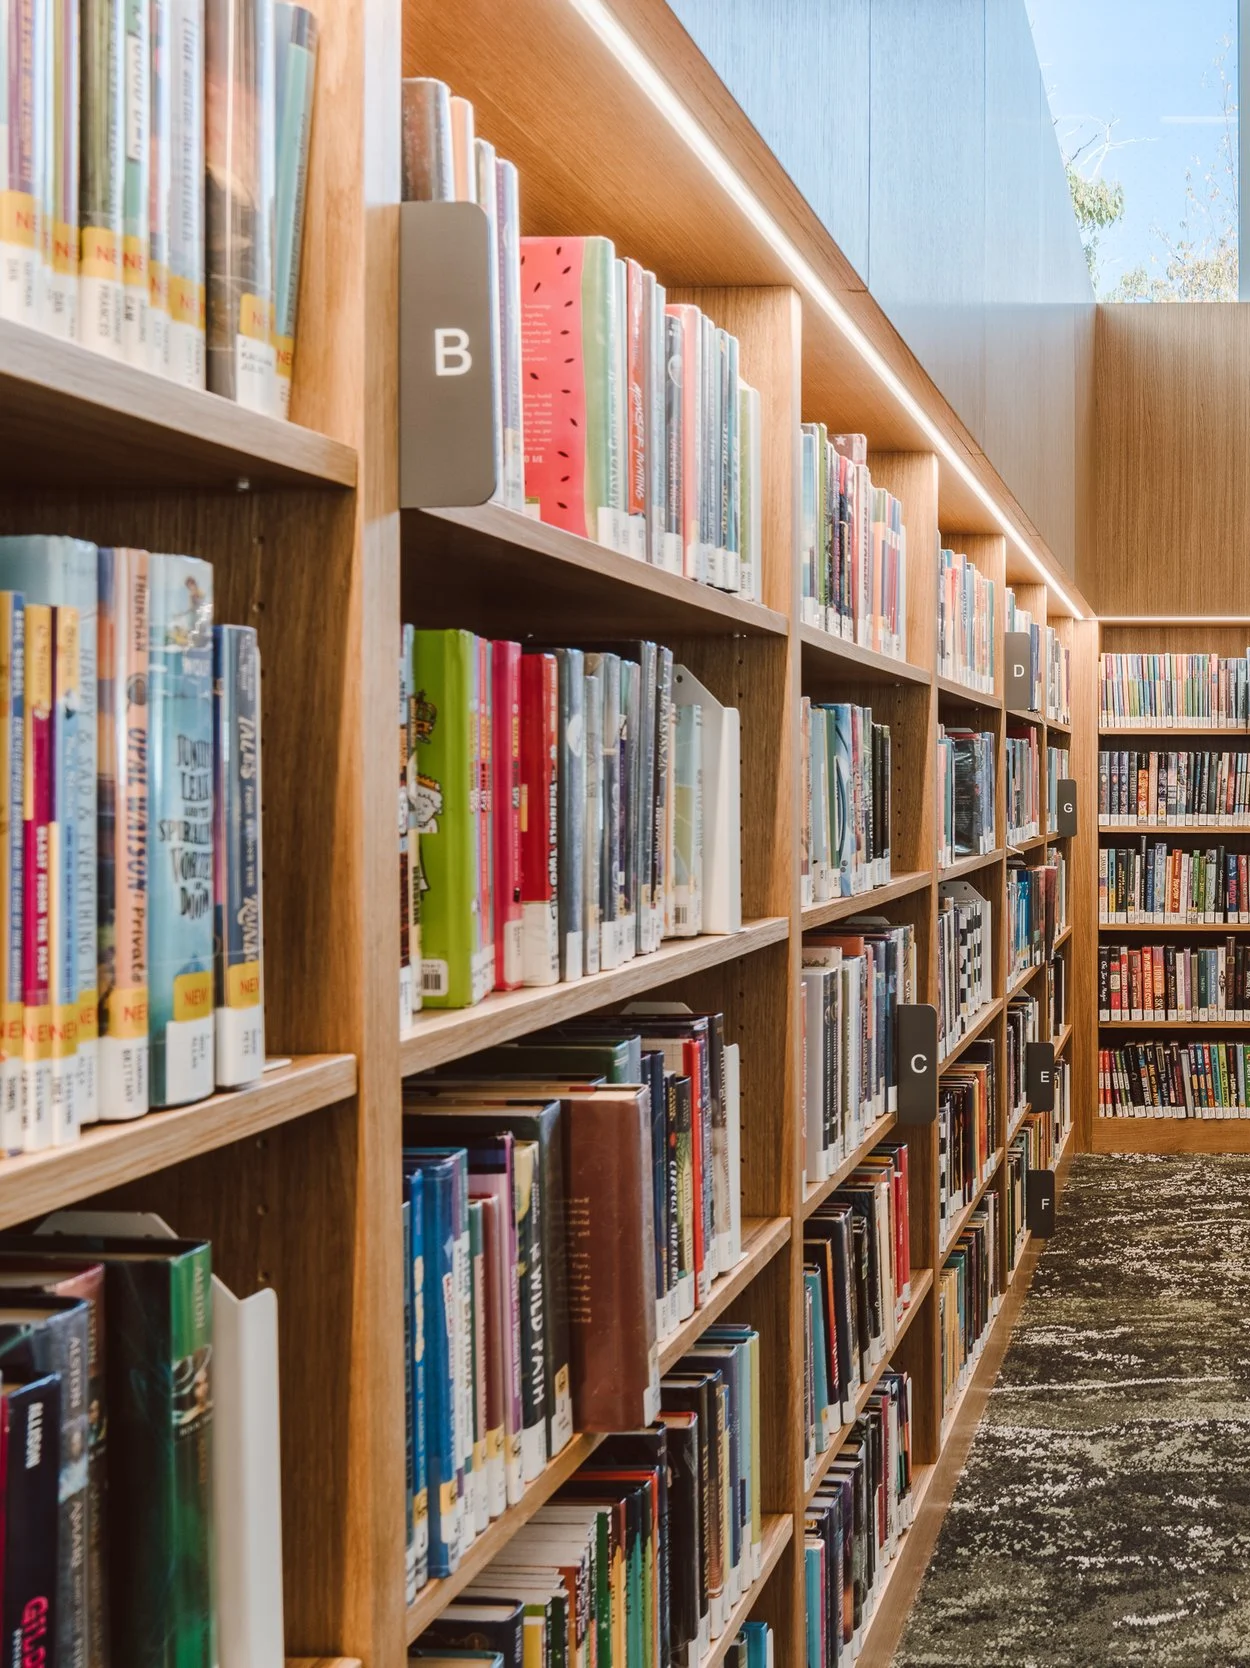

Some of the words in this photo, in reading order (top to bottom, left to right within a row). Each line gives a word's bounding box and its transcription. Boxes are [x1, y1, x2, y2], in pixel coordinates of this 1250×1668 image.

[434, 329, 473, 377] B
[634, 450, 646, 500] HUNTING
[1013, 664, 1024, 678] D
[127, 728, 147, 787] OPAL
[237, 715, 256, 781] TALES
[1063, 802, 1073, 813] G
[36, 826, 49, 870] BLAST
[547, 848, 558, 887] TWO
[36, 873, 48, 914] FROM
[1229, 879, 1238, 905] MAYDAY
[36, 917, 49, 943] THE
[132, 905, 144, 984] Private
[36, 945, 49, 981] PAST
[1153, 965, 1161, 981] LION
[184, 988, 209, 1006] NEW
[1100, 986, 1108, 1003] Magic
[1153, 998, 1162, 1011] SKY
[911, 1054, 927, 1074] C
[1040, 1071, 1050, 1083] E
[669, 1160, 678, 1216] CIRCUS
[1041, 1198, 1050, 1210] F
[194, 1266, 206, 1329] ALSTON
[529, 1263, 544, 1332] WILD
[69, 1336, 82, 1408] ALSTON
[530, 1338, 545, 1406] PATH
[71, 1501, 83, 1568] AMARI
